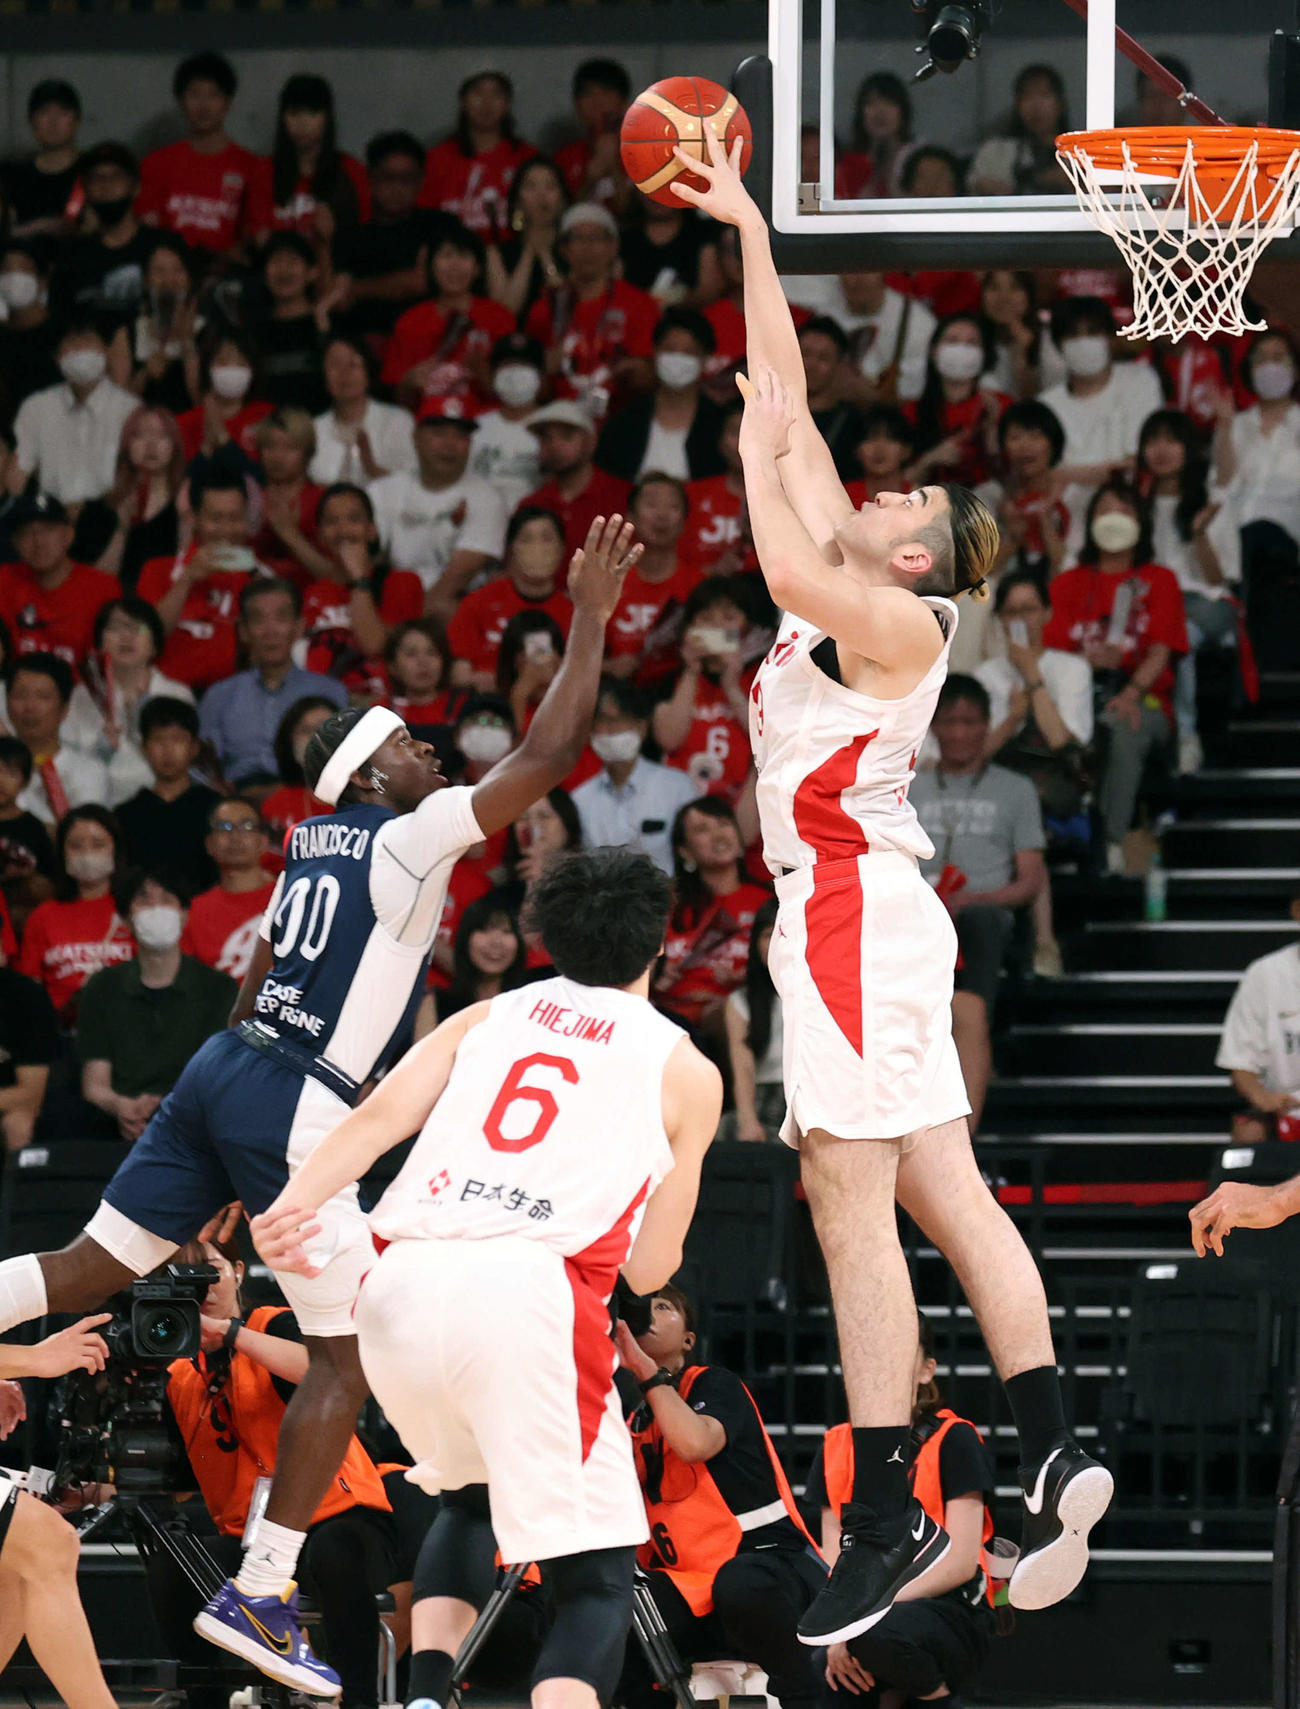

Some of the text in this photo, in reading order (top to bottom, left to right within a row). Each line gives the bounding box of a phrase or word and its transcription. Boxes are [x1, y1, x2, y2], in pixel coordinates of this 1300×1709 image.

[291, 824, 370, 861] FRANCISCO
[273, 874, 340, 961] 00
[528, 999, 616, 1045] HIEJIMA
[482, 1052, 580, 1154] 6
[459, 1179, 554, 1221] 日本生命
